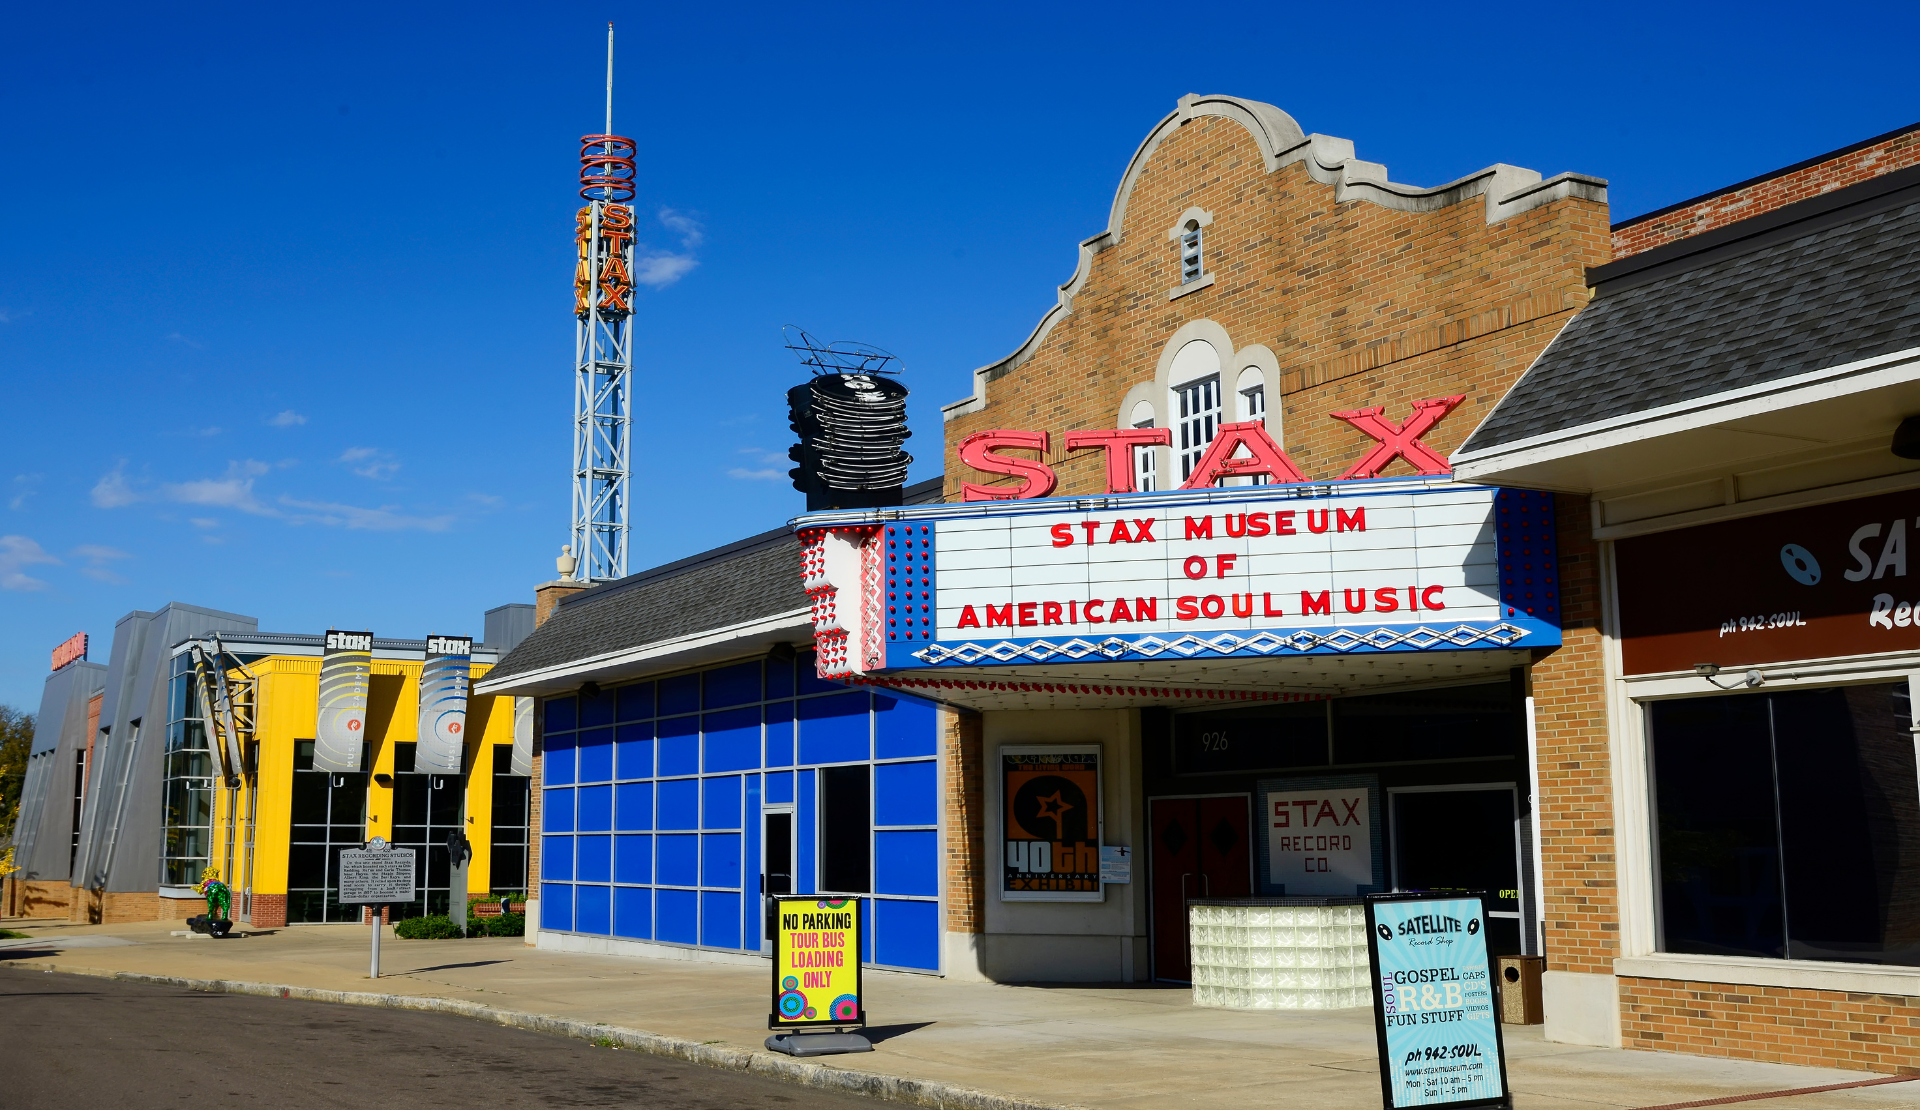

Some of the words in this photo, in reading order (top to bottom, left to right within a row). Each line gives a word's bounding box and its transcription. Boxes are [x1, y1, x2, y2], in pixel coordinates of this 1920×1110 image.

[600, 204, 631, 311] STAX
[957, 394, 1466, 502] STAX
[1050, 518, 1157, 548] STAX
[1185, 506, 1367, 540] MUSEUM
[1844, 516, 1920, 582] SA
[1183, 554, 1238, 581] OF
[957, 596, 1157, 629] AMERICAN
[1176, 592, 1283, 621] SOUL
[1300, 585, 1446, 616] MUSIC
[1719, 618, 1736, 638] ph
[1202, 731, 1228, 752] 926
[346, 737, 355, 768] MUSIC
[448, 738, 456, 770] MUSIC
[1273, 798, 1361, 828] STAX
[1281, 835, 1352, 852] RECORD
[1007, 841, 1098, 874] 40th
[1304, 857, 1332, 873] CO.
[783, 914, 798, 930] NO
[802, 913, 852, 930] PARKING
[1398, 914, 1462, 936] SATELLITE
[790, 932, 818, 948] TOUR
[822, 932, 845, 948] BUS
[1409, 937, 1434, 946] Record
[1436, 936, 1454, 947] Shop
[792, 951, 843, 968] LOADING
[804, 971, 832, 988] ONLY
[1394, 968, 1459, 984] GOSPEL
[1462, 971, 1486, 980] CAPS
[1383, 972, 1396, 1014] SOUL
[1464, 980, 1487, 991] CD'S
[1396, 982, 1463, 1012] R&B
[1465, 997, 1488, 1005] BOOKS
[1466, 1004, 1489, 1012] VIDEOS
[1467, 1012, 1490, 1020] GIFTS
[1386, 1014, 1416, 1027] FUN
[1422, 1010, 1464, 1024] STUFF
[1405, 1048, 1422, 1066] ph
[1405, 1062, 1482, 1076] www.staxmuseum.com
[1406, 1080, 1420, 1088] Mon
[1427, 1078, 1438, 1086] Sat
[1441, 1077, 1448, 1085] 10
[1474, 1074, 1483, 1082] pm
[1425, 1088, 1437, 1097] Sun
[1452, 1086, 1455, 1094] 5
